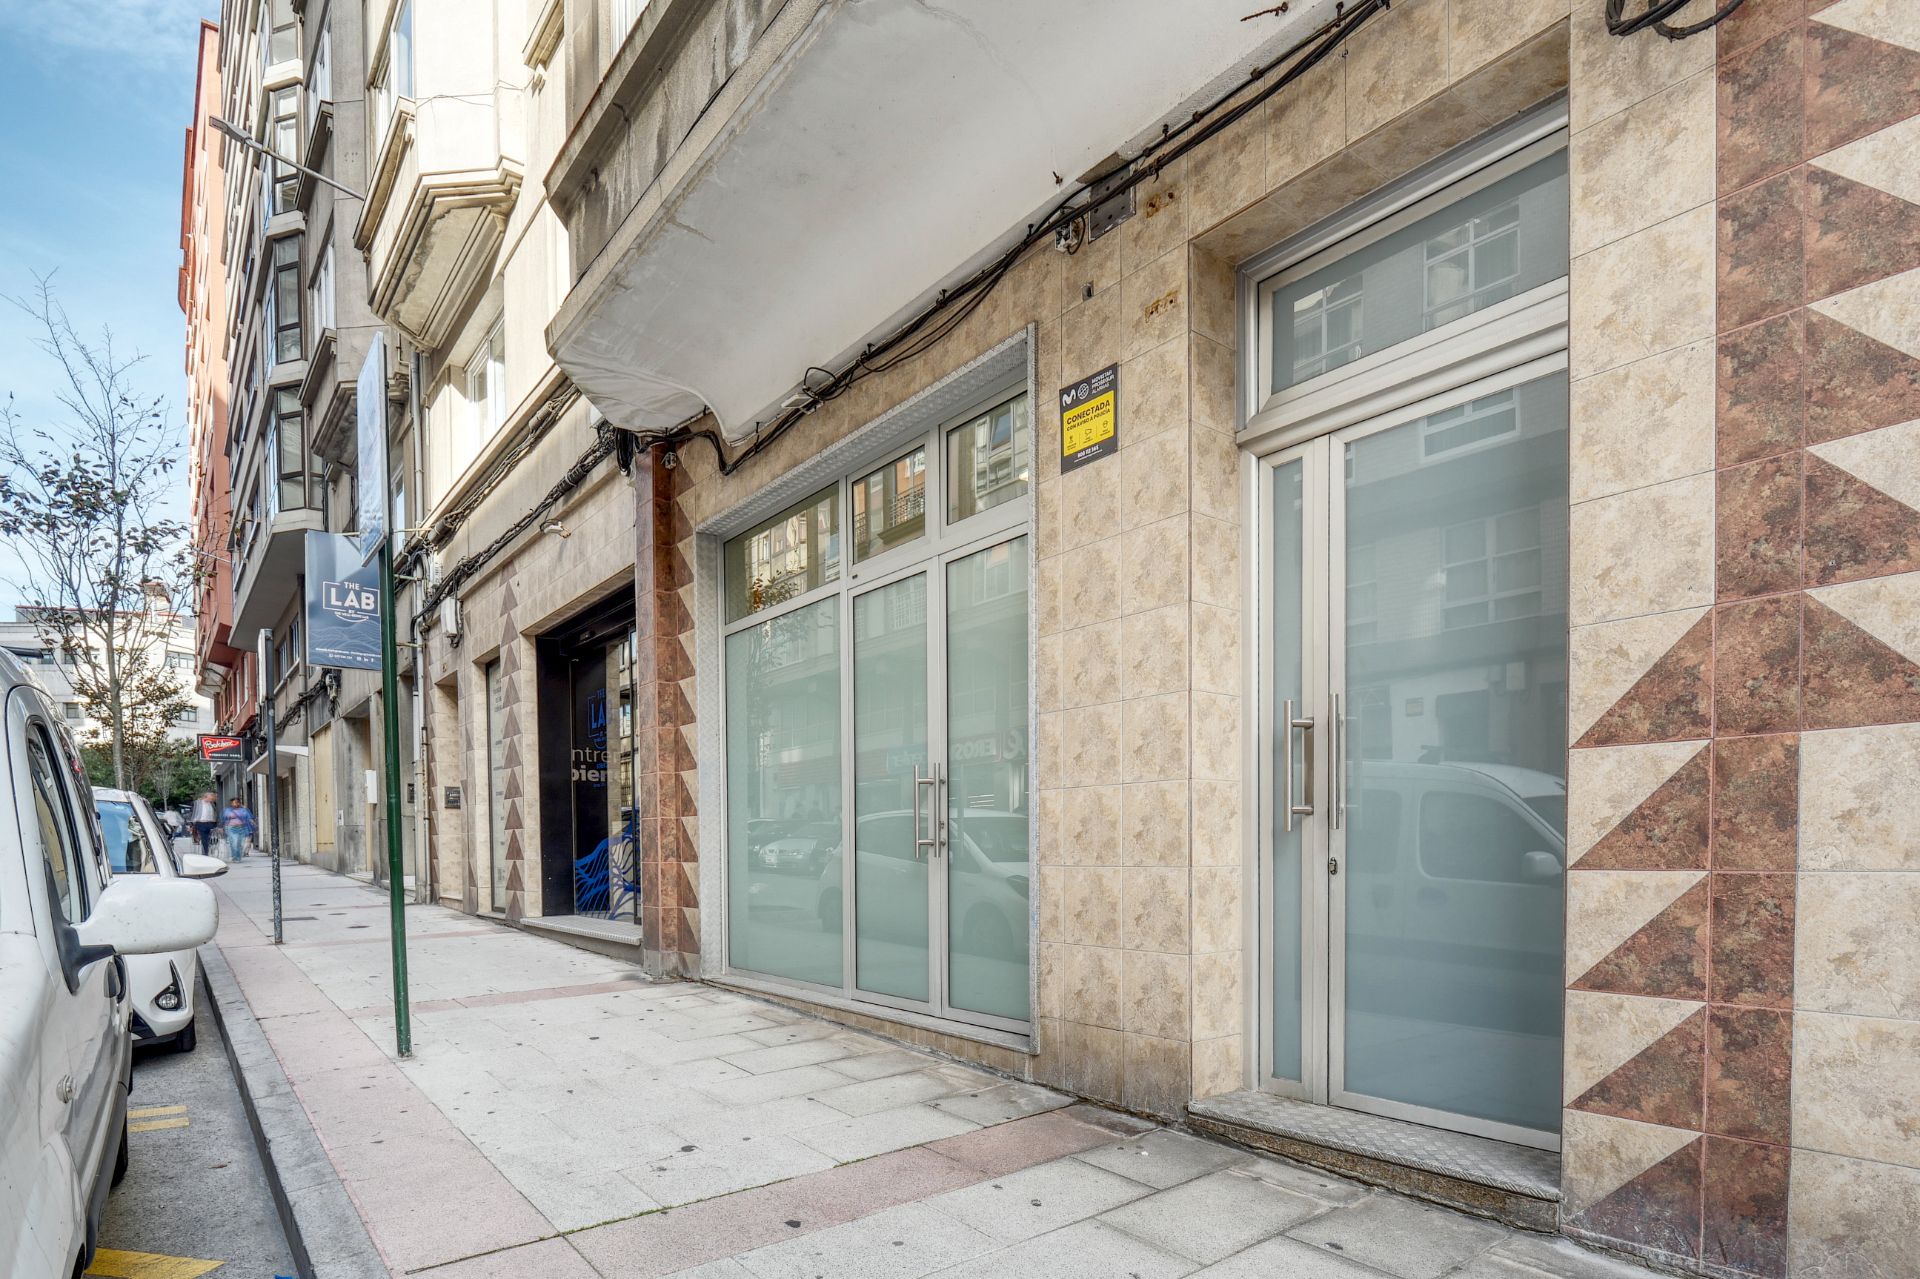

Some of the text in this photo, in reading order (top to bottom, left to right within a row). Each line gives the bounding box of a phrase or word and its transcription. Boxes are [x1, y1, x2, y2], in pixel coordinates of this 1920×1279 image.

[1066, 399, 1111, 425] CONECTADA
[343, 581, 360, 590] THE
[330, 587, 375, 610] LAB
